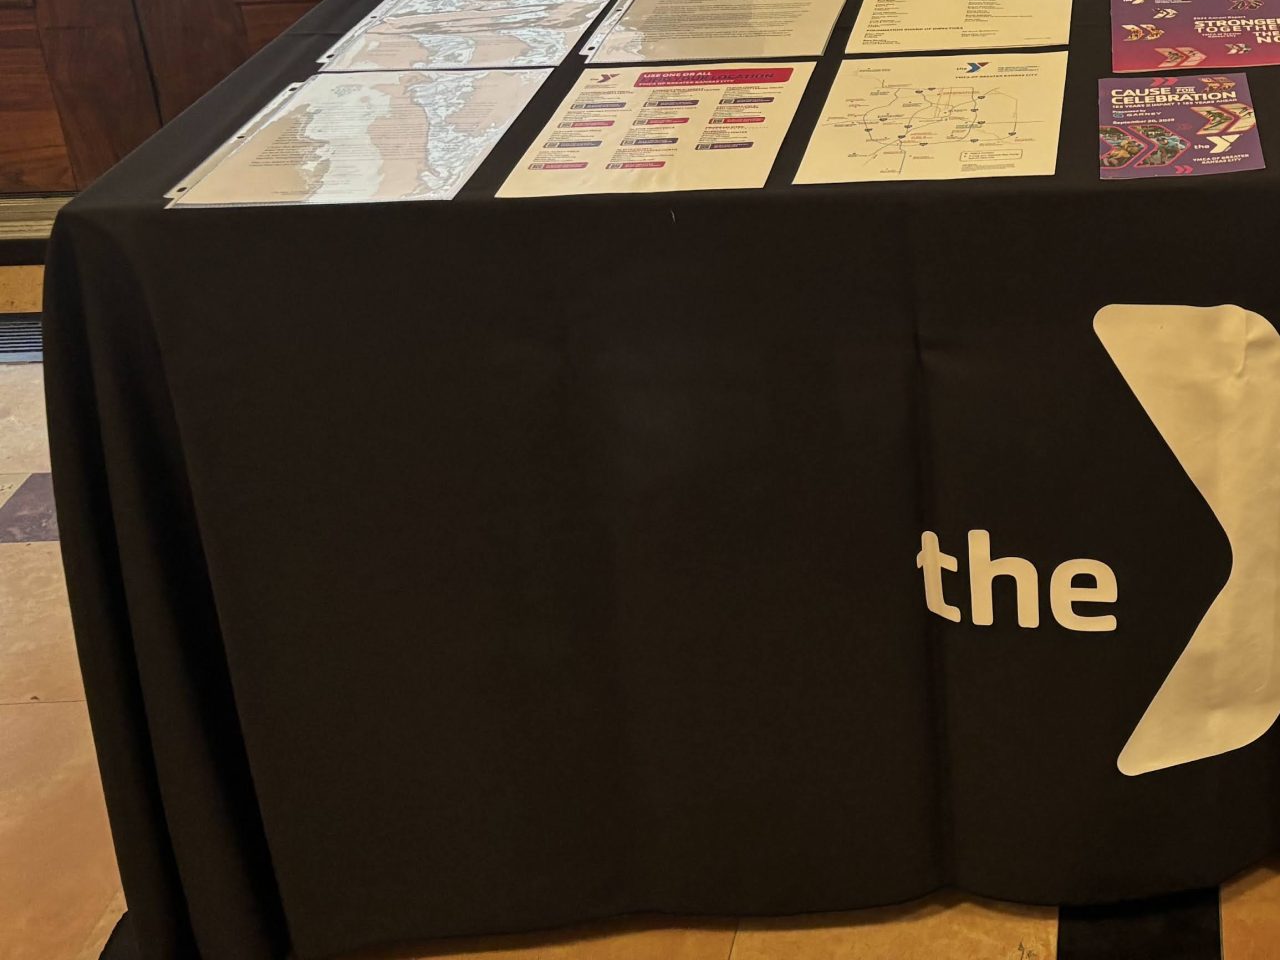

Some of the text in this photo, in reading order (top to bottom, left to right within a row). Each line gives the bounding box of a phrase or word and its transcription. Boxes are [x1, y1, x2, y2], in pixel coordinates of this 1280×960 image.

[1112, 87, 1171, 96] CAUSE
[1112, 91, 1236, 104] CELEBRATION
[916, 530, 1118, 632] the
